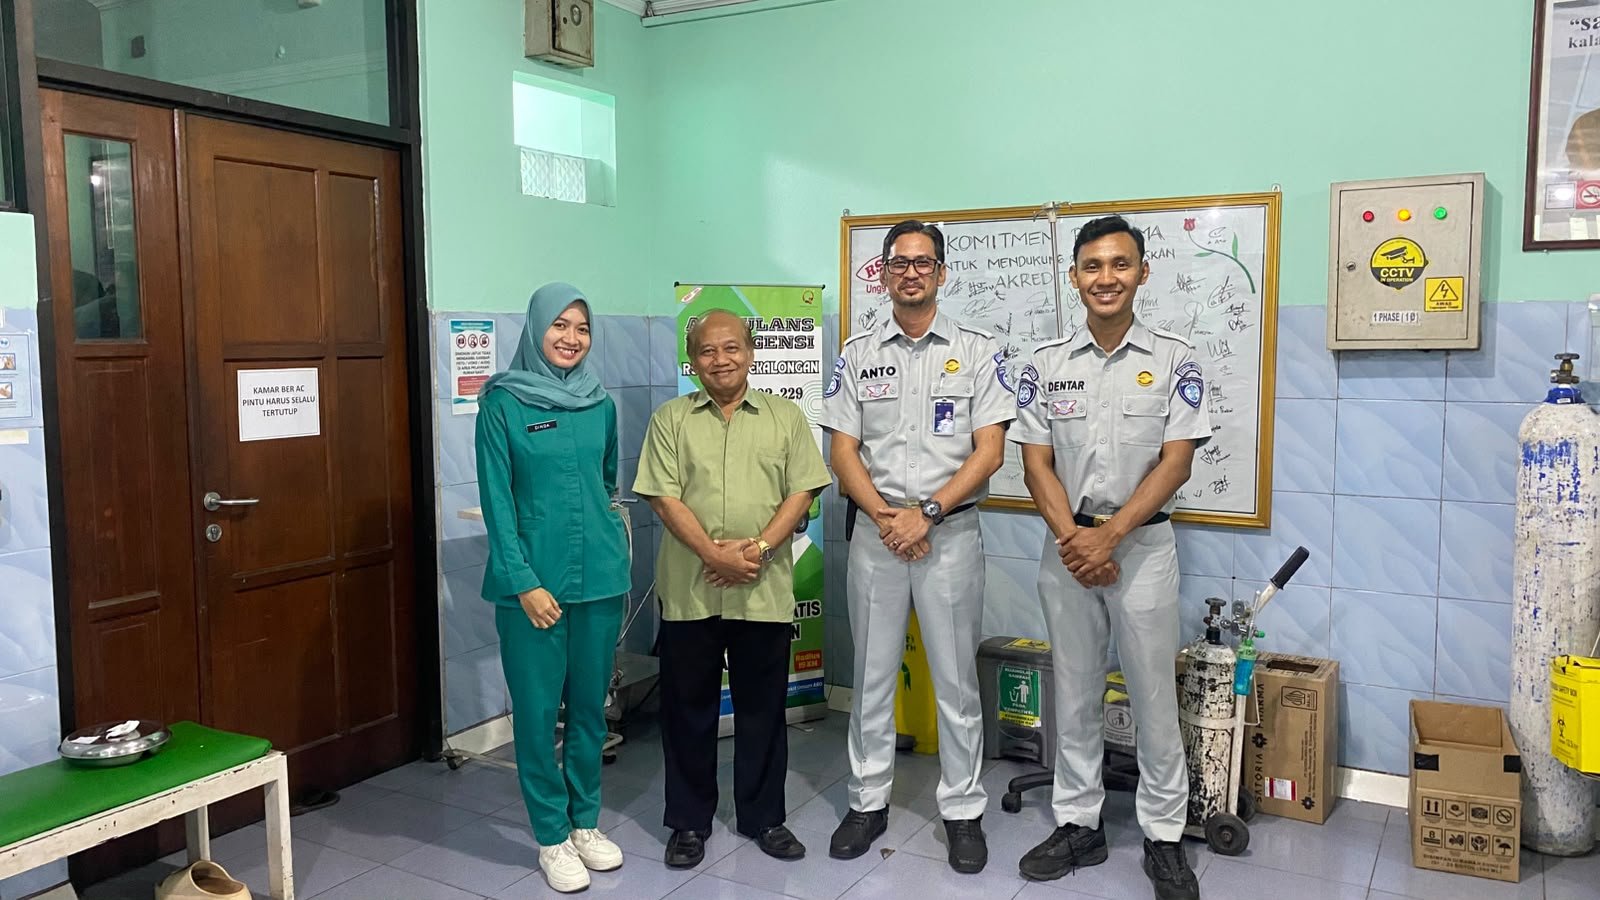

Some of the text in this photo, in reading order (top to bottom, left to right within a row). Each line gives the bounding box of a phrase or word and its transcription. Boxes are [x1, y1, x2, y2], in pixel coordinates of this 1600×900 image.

[946, 231, 1052, 255] KOMITMEN
[946, 258, 978, 272] NTUK
[1380, 267, 1414, 278] CCTV
[1378, 312, 1400, 322] PHASE
[859, 366, 897, 380] ANTO
[253, 386, 280, 394] KAMAR
[281, 385, 295, 393] BER
[1048, 380, 1085, 393] DENTAR
[242, 396, 316, 406] PINTU HARUS SELALU
[262, 408, 298, 417] TERTUTUP
[1254, 753, 1263, 803] SATORIA
